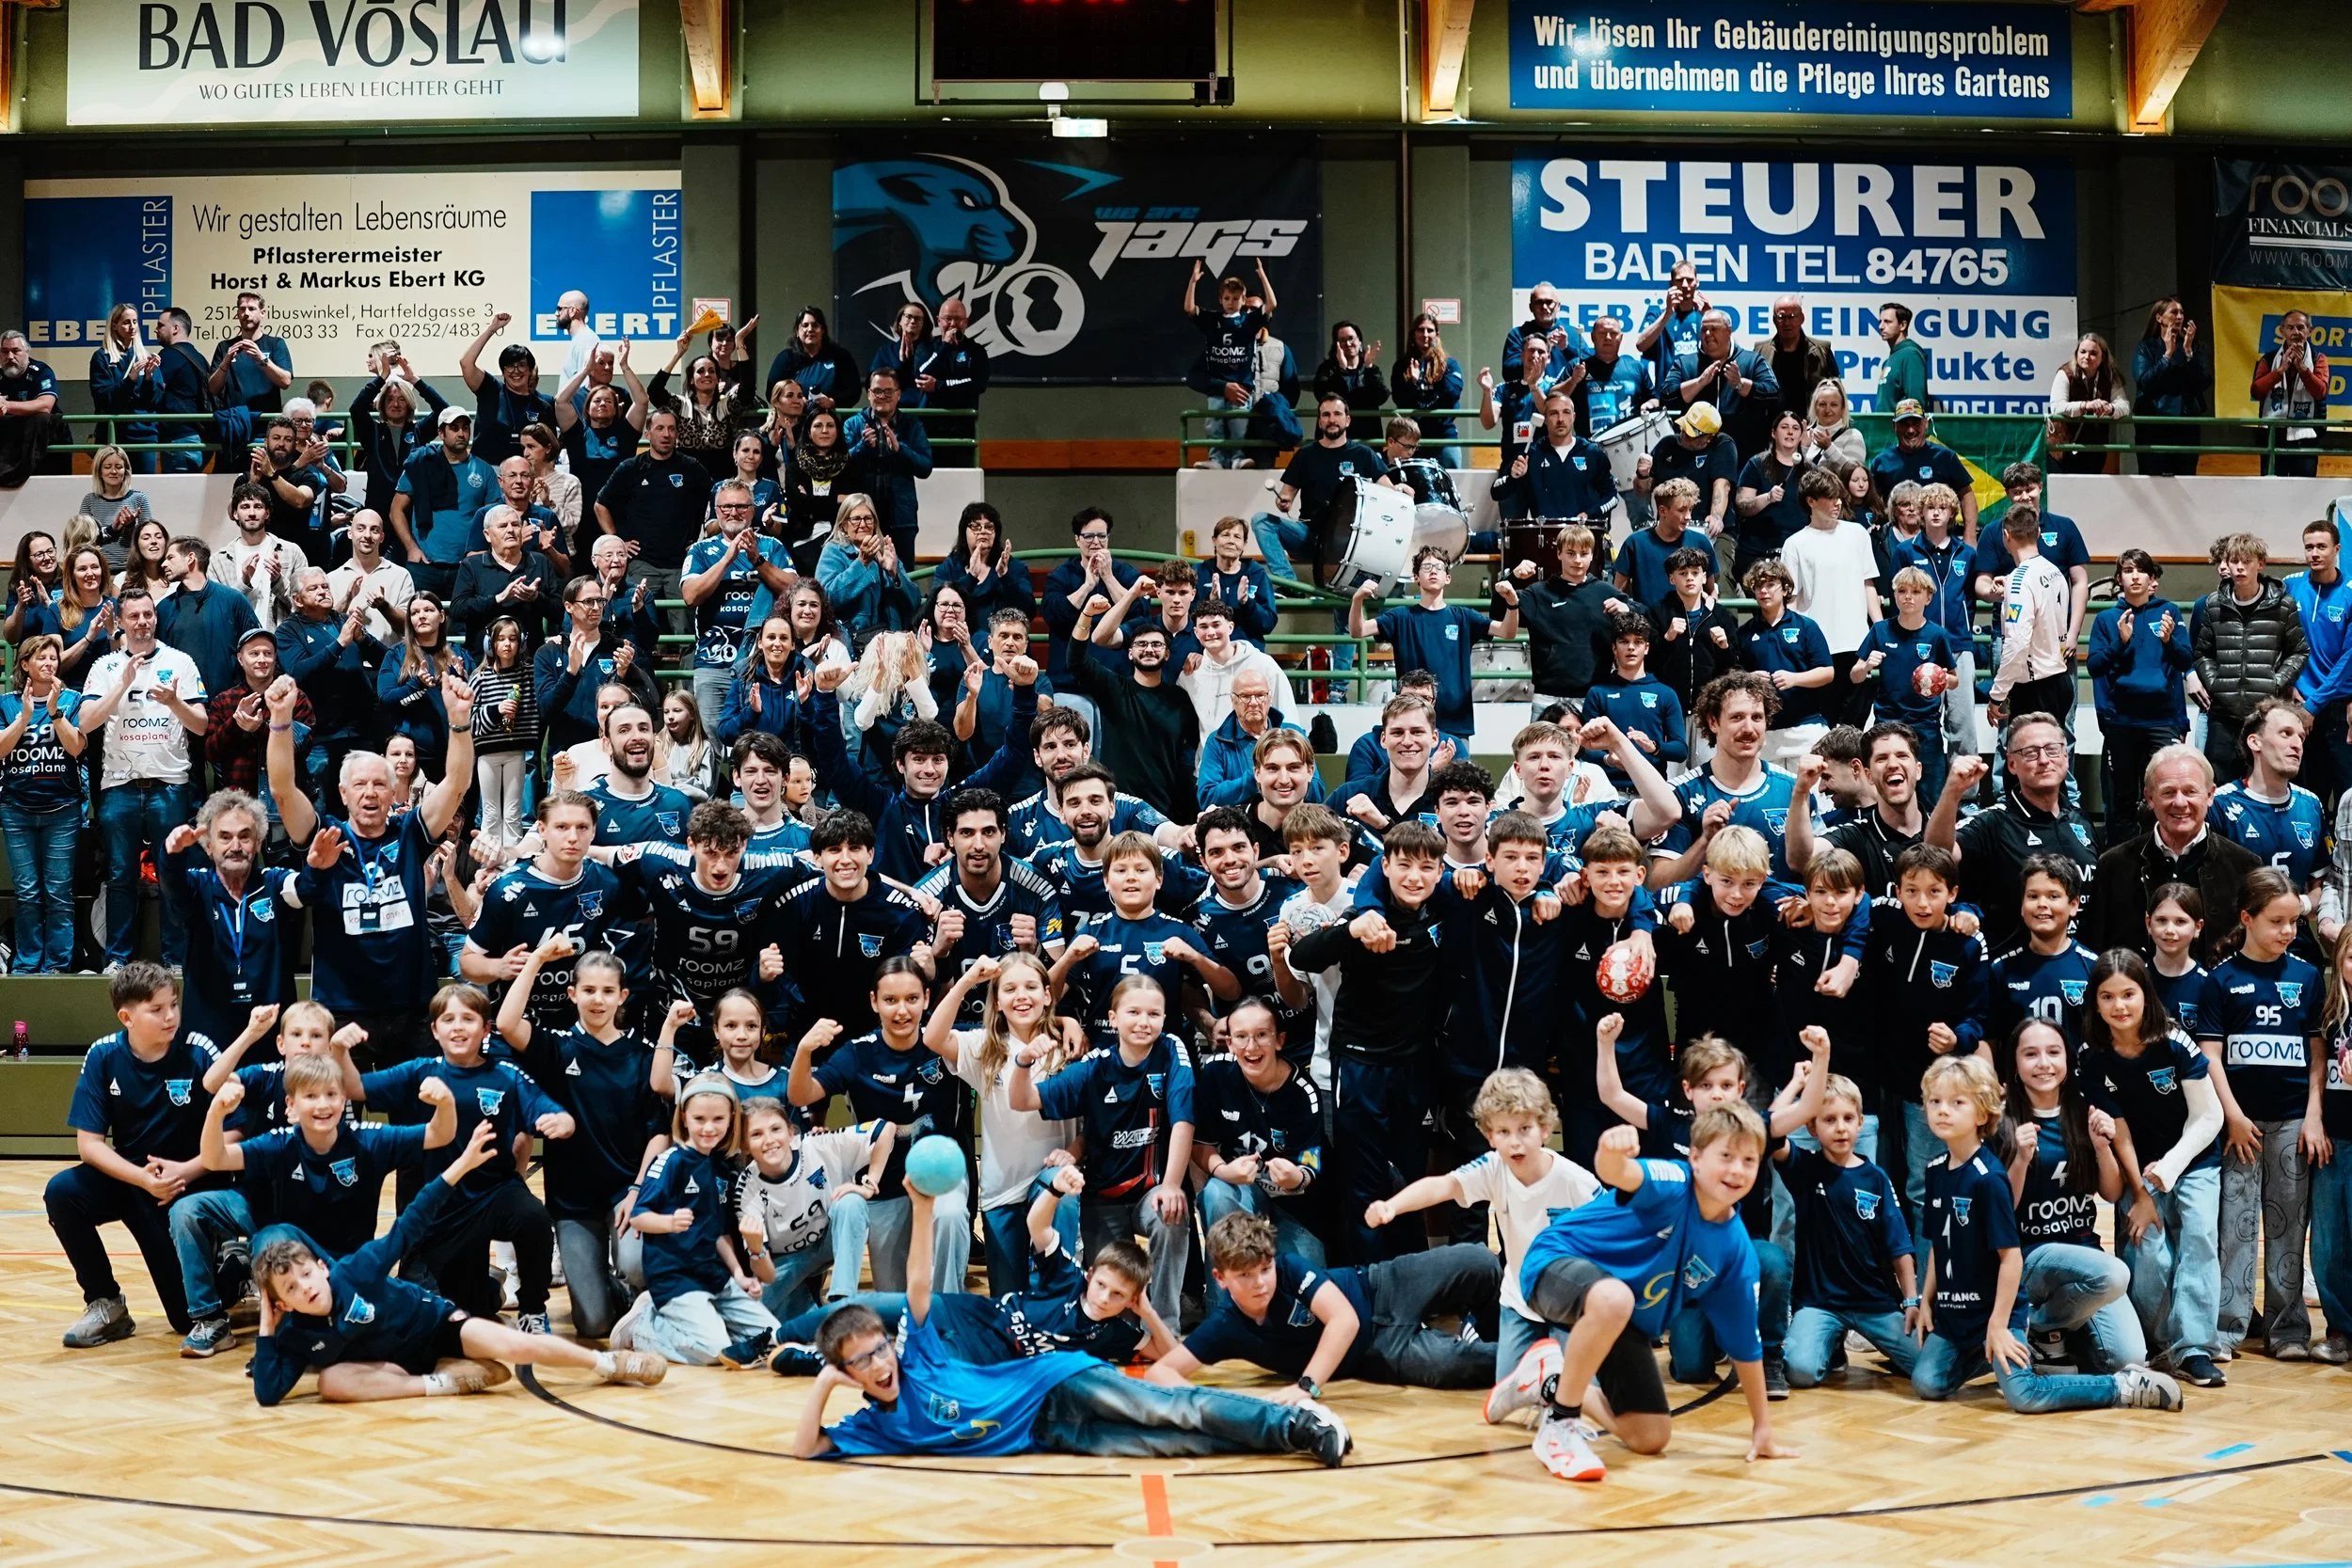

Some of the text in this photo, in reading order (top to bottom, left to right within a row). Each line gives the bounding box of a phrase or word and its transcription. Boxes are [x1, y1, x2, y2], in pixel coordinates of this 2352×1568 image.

[139, 1, 284, 70] BAD
[1534, 16, 2049, 61] Wir lösen Ihr Gebäudereinigungsproblem
[199, 79, 504, 100] WO GUTES LEBEN LEICHTER GEHT
[1534, 60, 2050, 99] und übernehmen die Pflege Ihres Gartens
[1540, 159, 2046, 240] STEURER
[192, 200, 507, 239] Wir gestalten Lebensräume
[1094, 206, 1201, 219] we are
[142, 198, 167, 314] PFLASTER
[253, 246, 443, 264] Pflasterermeister
[652, 192, 677, 308] PFLASTER
[2249, 249, 2352, 269] WWW.ROOM
[1585, 243, 1748, 283] BADEN
[211, 270, 485, 290] Horst & Markus Ebert KG
[266, 304, 356, 322] ibuswinkel,
[361, 303, 475, 321] Hartfeldgasse
[535, 312, 677, 336] EERT
[29, 321, 160, 342] EBET
[357, 325, 384, 338] Fax
[389, 323, 481, 340] 02252/483
[720, 604, 752, 614] kosap
[24, 722, 56, 745] 59
[689, 926, 739, 956] 59
[2255, 1006, 2282, 1026] 95
